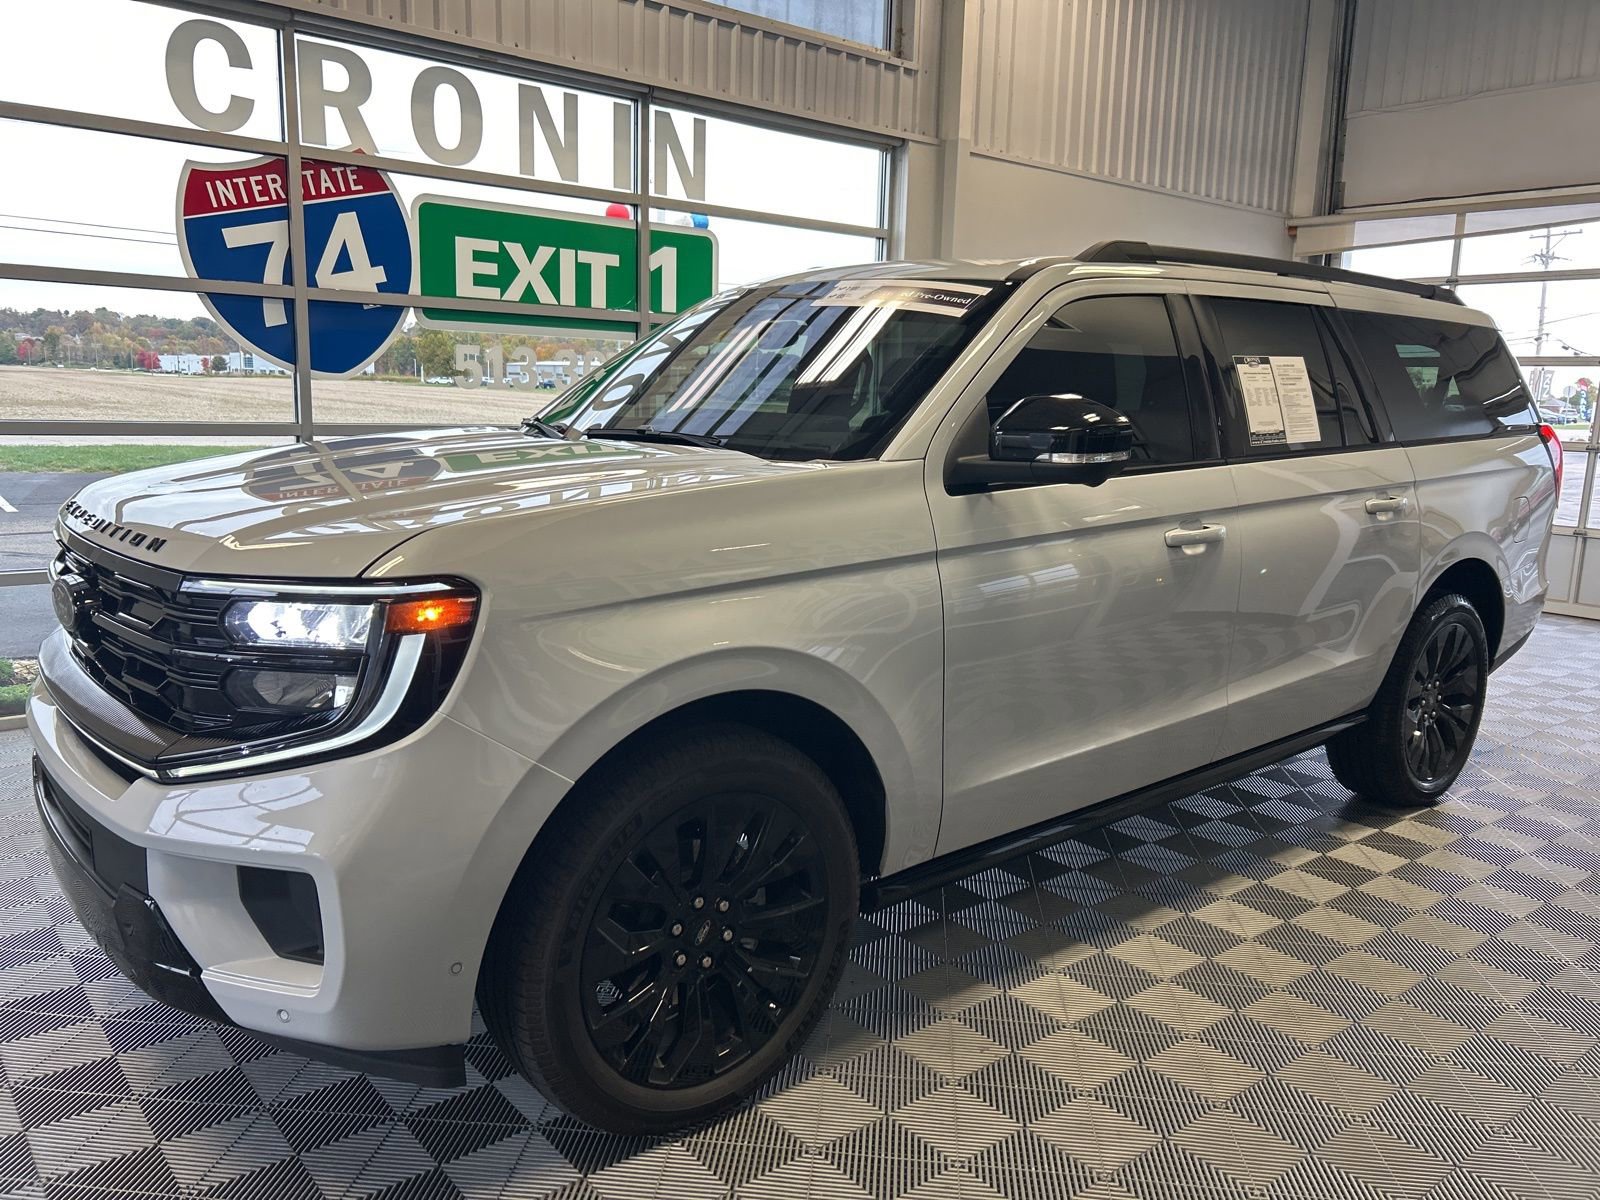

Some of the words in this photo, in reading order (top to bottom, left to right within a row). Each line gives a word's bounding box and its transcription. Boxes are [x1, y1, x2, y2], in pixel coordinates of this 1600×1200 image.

[165, 18, 706, 202] CRONIN
[206, 167, 363, 208] INTERTATE
[221, 211, 388, 328] 74
[455, 236, 620, 309] EXIT
[649, 246, 678, 313] 1
[912, 290, 973, 305] Pre-Owned
[66, 501, 167, 552] EXPEDITION
